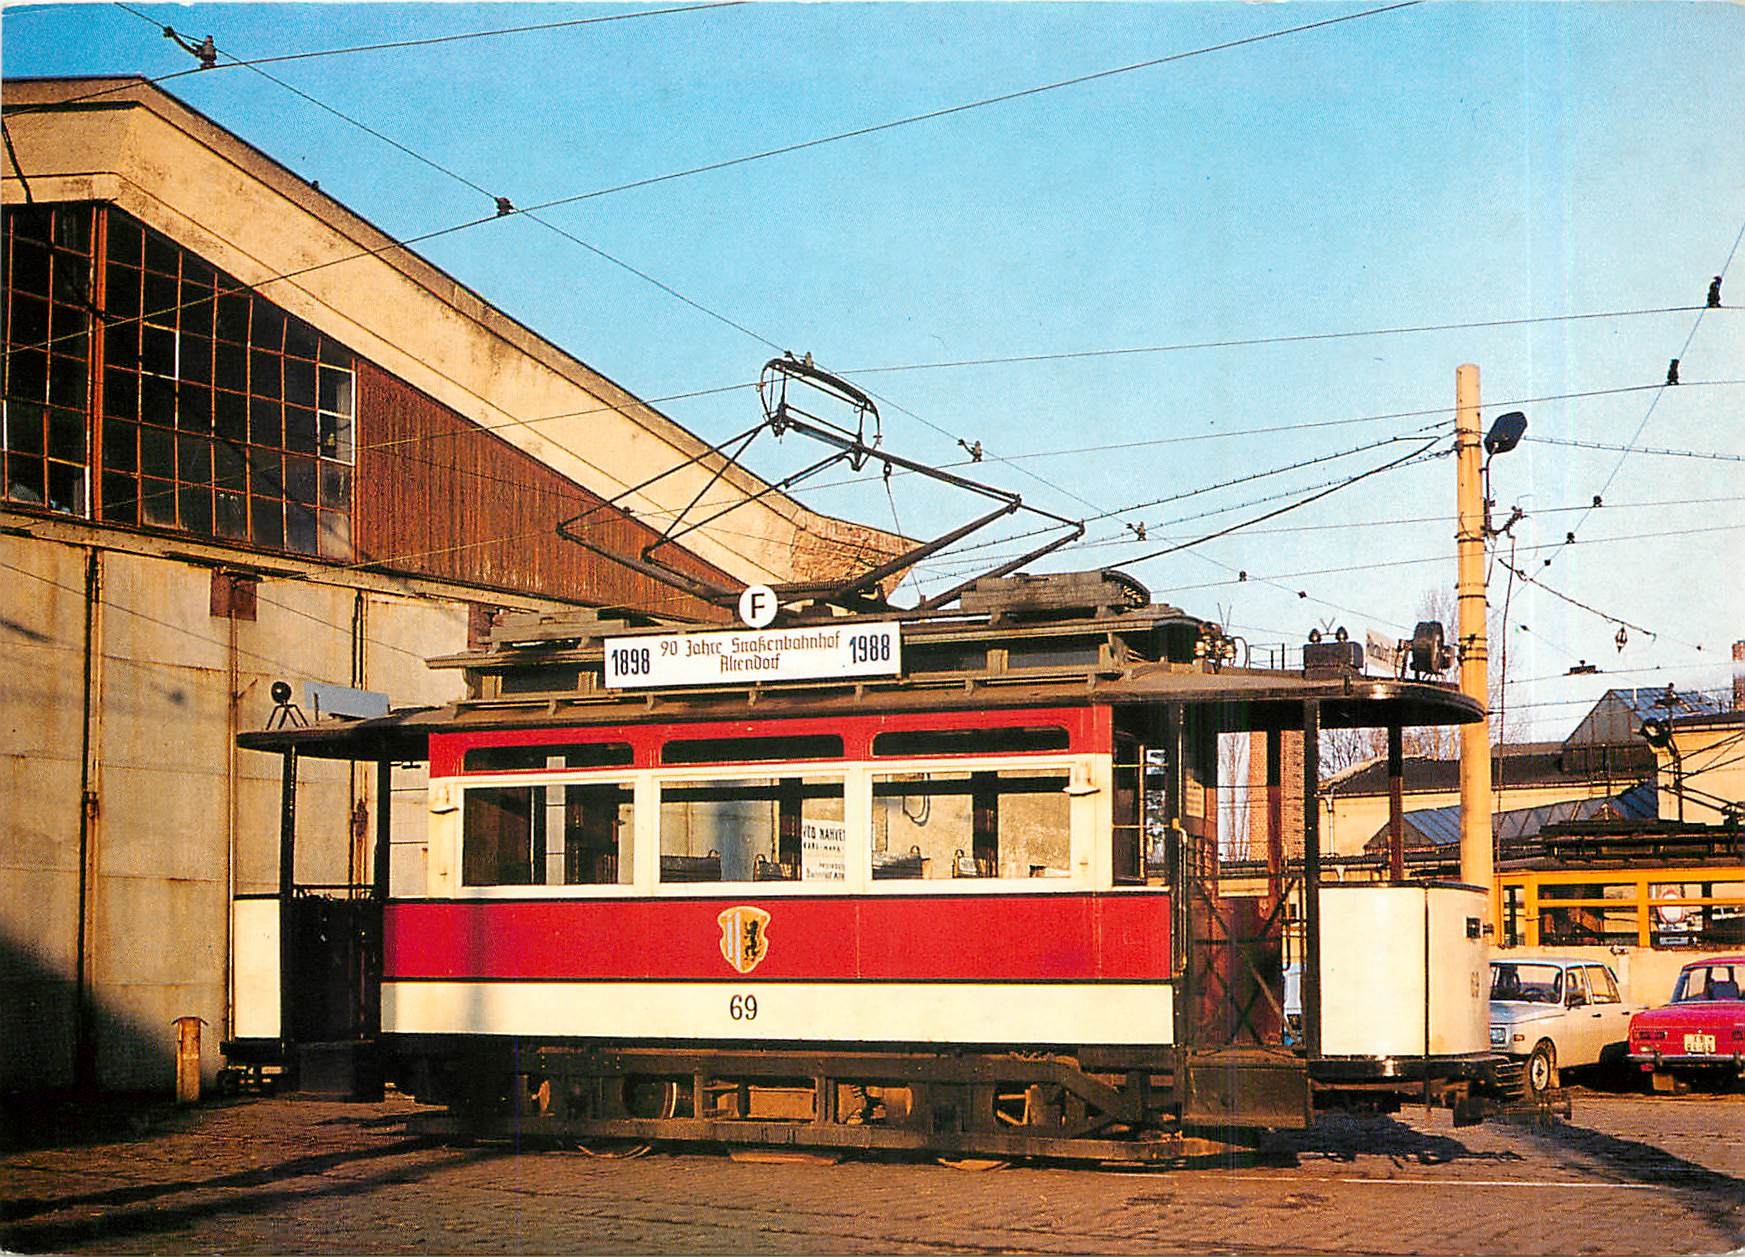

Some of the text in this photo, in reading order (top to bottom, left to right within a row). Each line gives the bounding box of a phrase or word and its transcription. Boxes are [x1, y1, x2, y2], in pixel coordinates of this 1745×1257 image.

[750, 592, 766, 619] F
[611, 647, 651, 677] 1898
[660, 640, 678, 657] 90
[685, 639, 723, 658] Jahre
[849, 633, 891, 665] 1988
[729, 993, 758, 1020] 69
